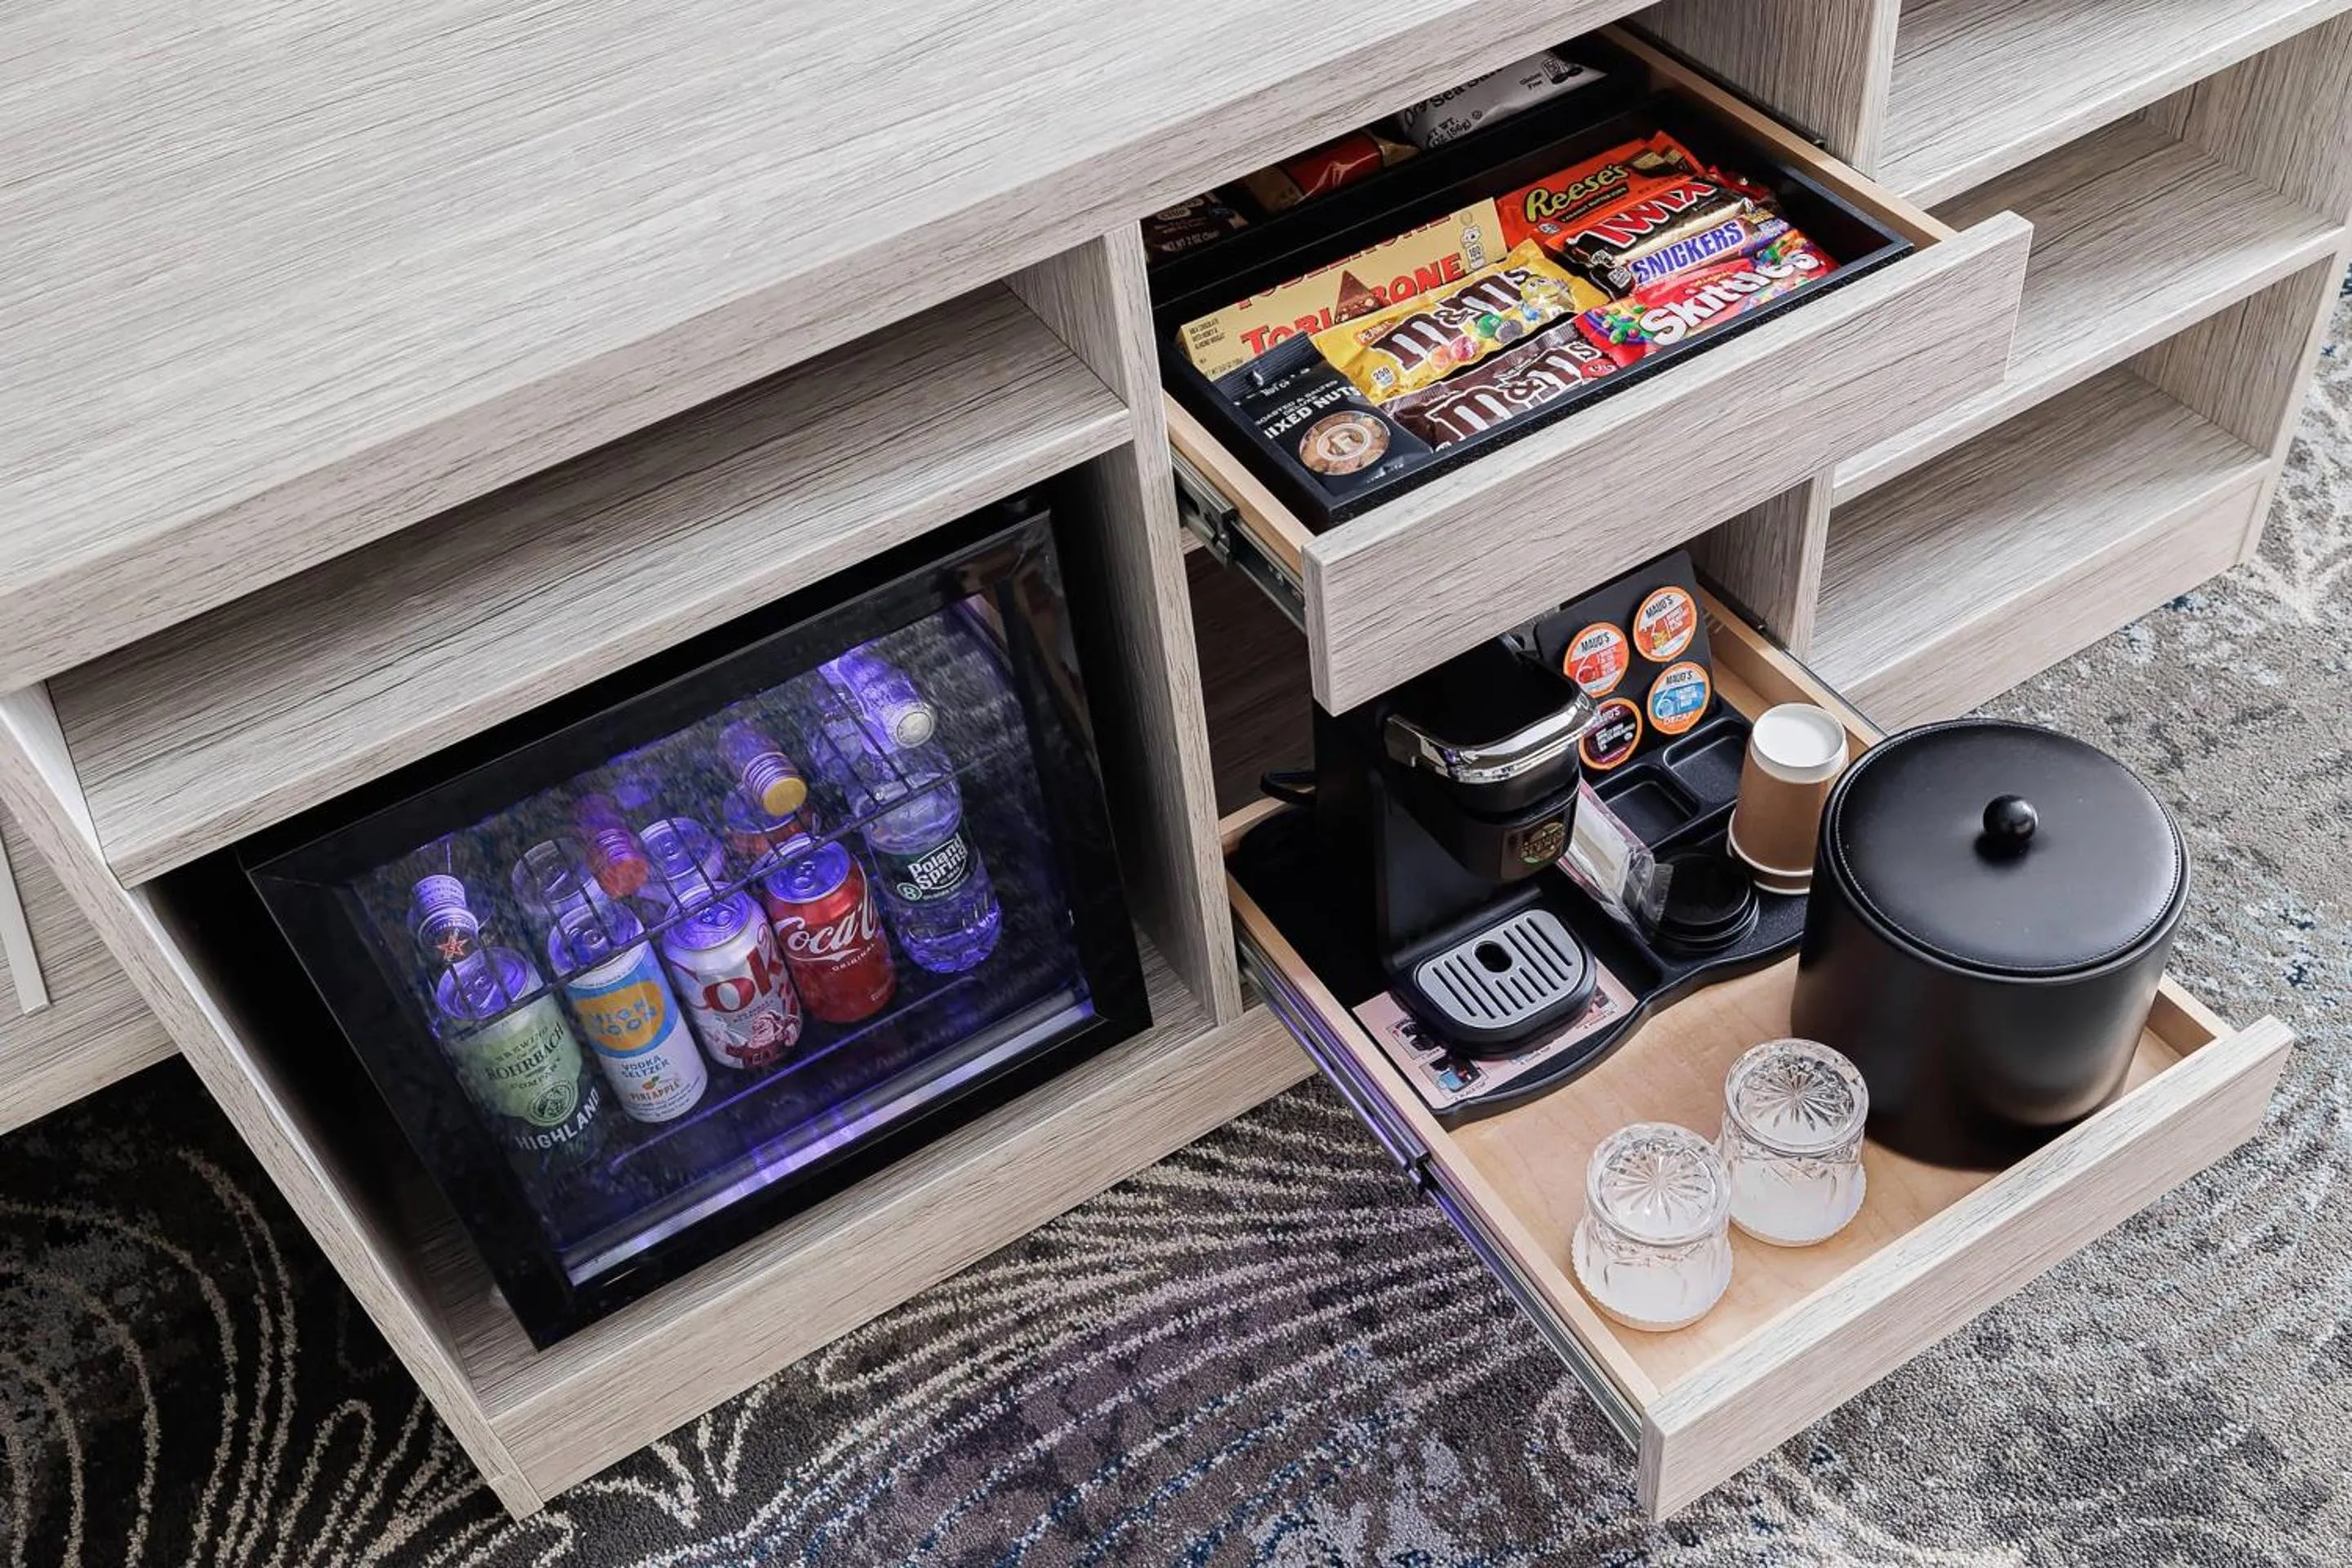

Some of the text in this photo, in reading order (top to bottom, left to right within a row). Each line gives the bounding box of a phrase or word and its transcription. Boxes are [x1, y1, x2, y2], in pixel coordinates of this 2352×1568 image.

[1581, 181, 1717, 247] TWIX
[1631, 220, 1744, 283] SNICKERS
[1640, 250, 1820, 345] Skittles
[1263, 408, 1313, 440] IXED
[908, 831, 964, 879] Poland
[915, 846, 969, 890] Spring
[515, 1086, 600, 1151] HIGHLAND
